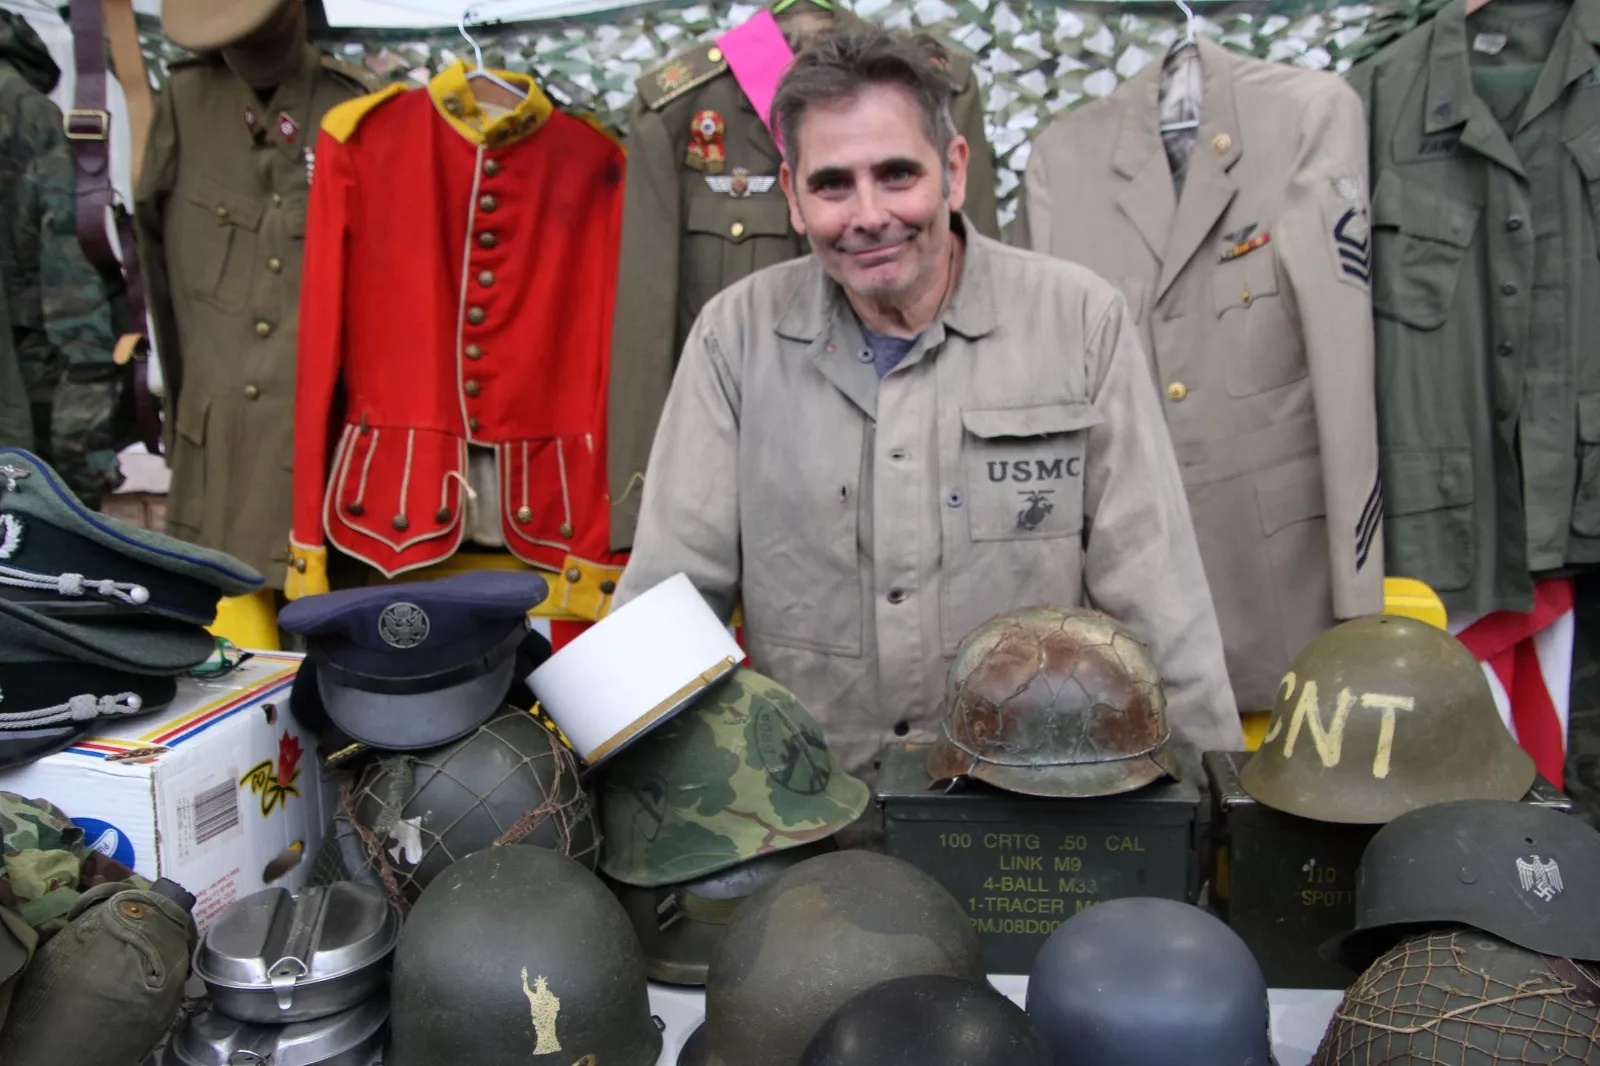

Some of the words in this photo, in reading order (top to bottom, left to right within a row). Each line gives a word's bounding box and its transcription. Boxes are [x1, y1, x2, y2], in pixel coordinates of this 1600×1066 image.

[986, 457, 1081, 483] USMC
[939, 833, 972, 849] 100
[983, 834, 1041, 850] CRTG
[1058, 835, 1088, 850] .50
[1105, 836, 1146, 851] CAL
[999, 856, 1044, 871] LINK
[1054, 856, 1083, 872] M9
[983, 876, 1050, 892] 4-BALL
[968, 897, 1065, 914] 1-TRACER
